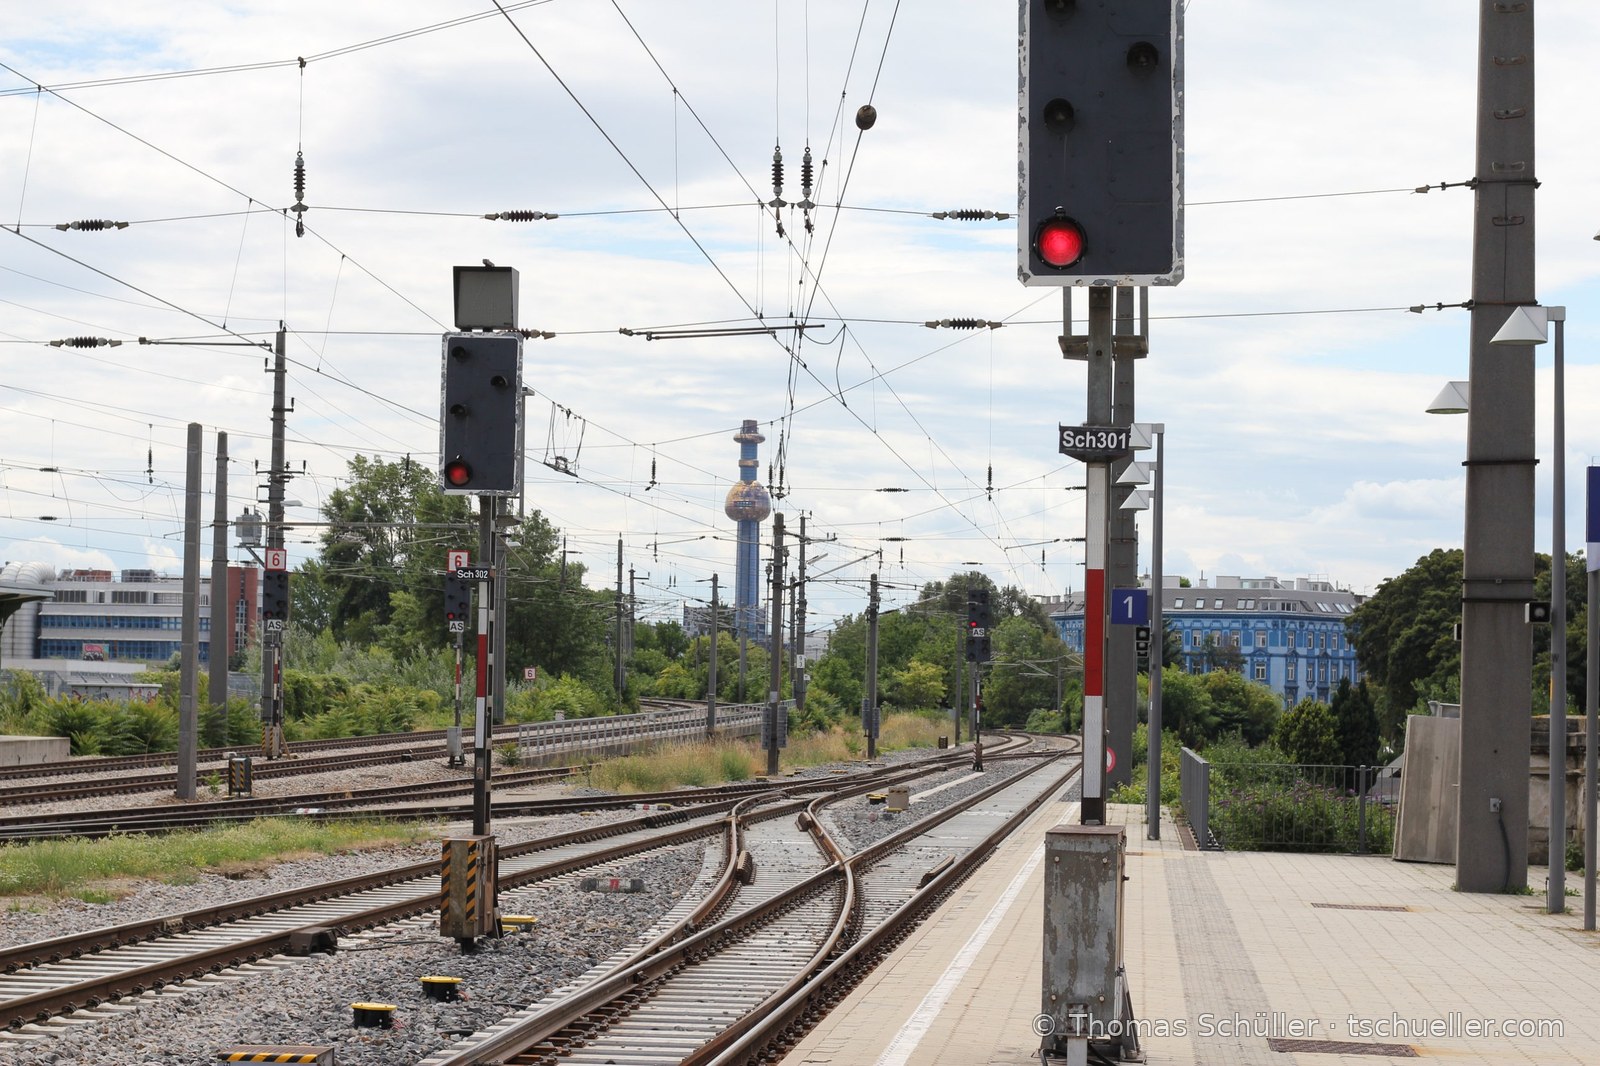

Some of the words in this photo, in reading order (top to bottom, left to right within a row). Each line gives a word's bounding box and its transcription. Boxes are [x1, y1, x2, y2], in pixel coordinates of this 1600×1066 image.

[1062, 430, 1126, 449] Sch301
[272, 552, 280, 567] 6
[454, 554, 462, 568] 6
[1123, 595, 1133, 619] 1
[267, 620, 282, 630] AS
[450, 622, 464, 631] AS
[973, 628, 984, 636] AS
[527, 669, 533, 678] 6
